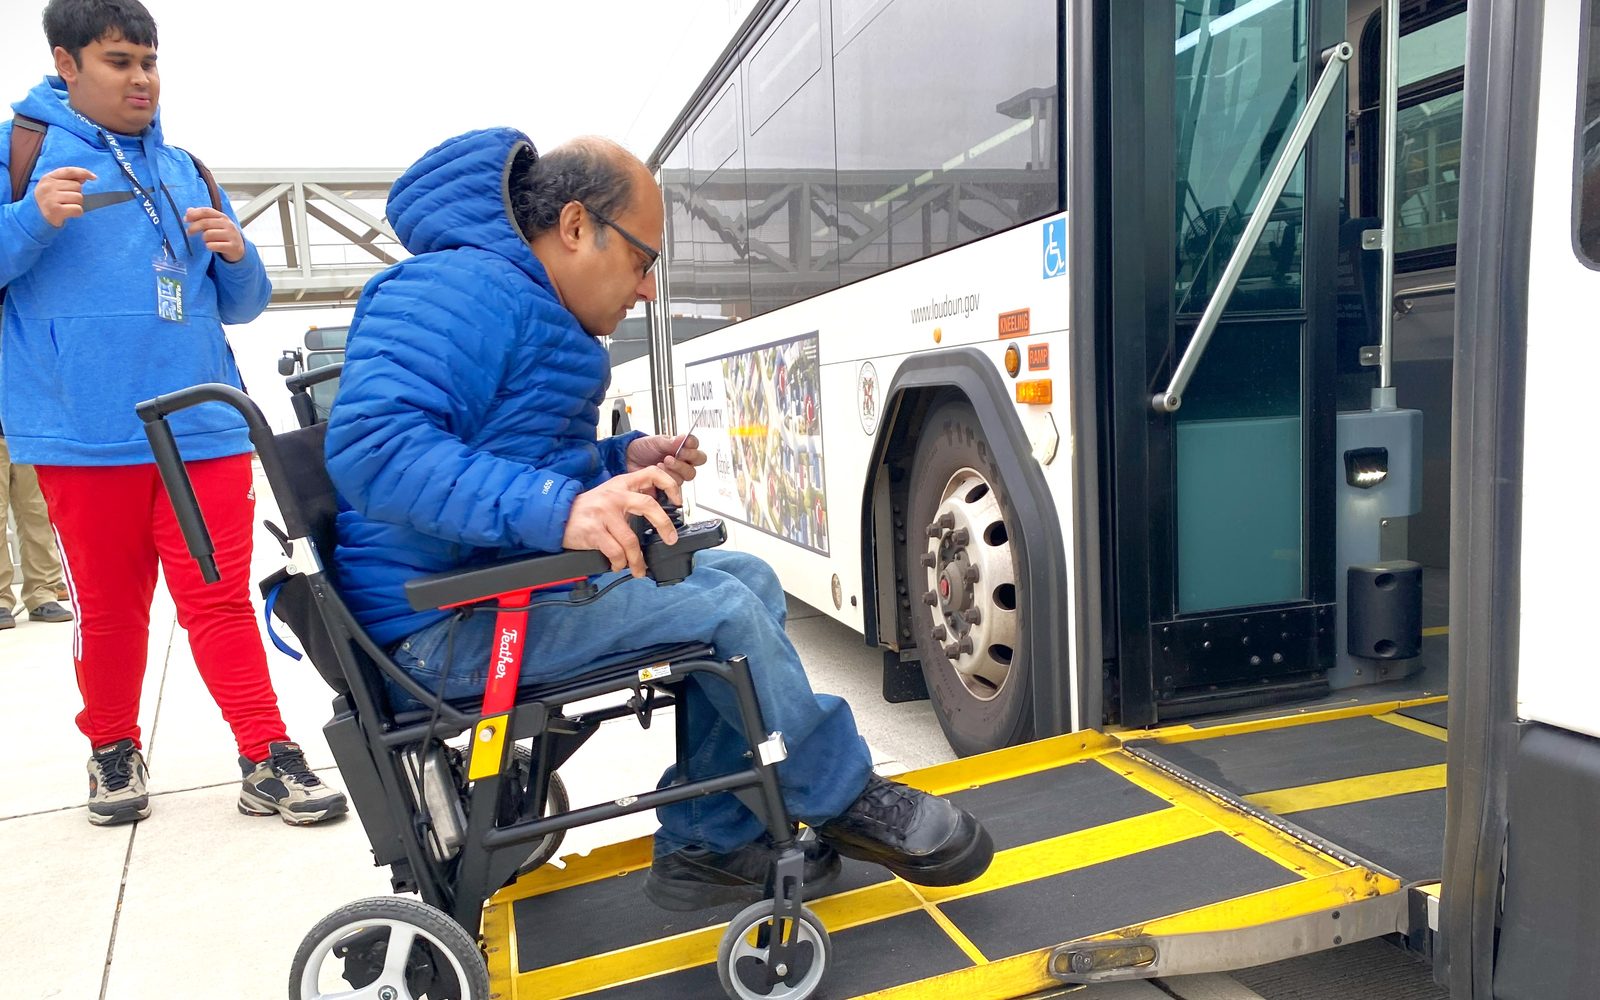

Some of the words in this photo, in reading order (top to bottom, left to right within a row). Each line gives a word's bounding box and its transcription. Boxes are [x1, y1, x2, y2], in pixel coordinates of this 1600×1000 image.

[106, 134, 118, 147] All
[114, 147, 125, 160] for
[143, 199, 160, 225] DATA
[911, 293, 980, 324] www.loudoun.gov
[1000, 313, 1028, 334] KNEELING
[1029, 348, 1047, 365] RAMP
[690, 382, 701, 401] JOIN
[701, 380, 713, 400] OUR
[495, 628, 517, 680] Feather
